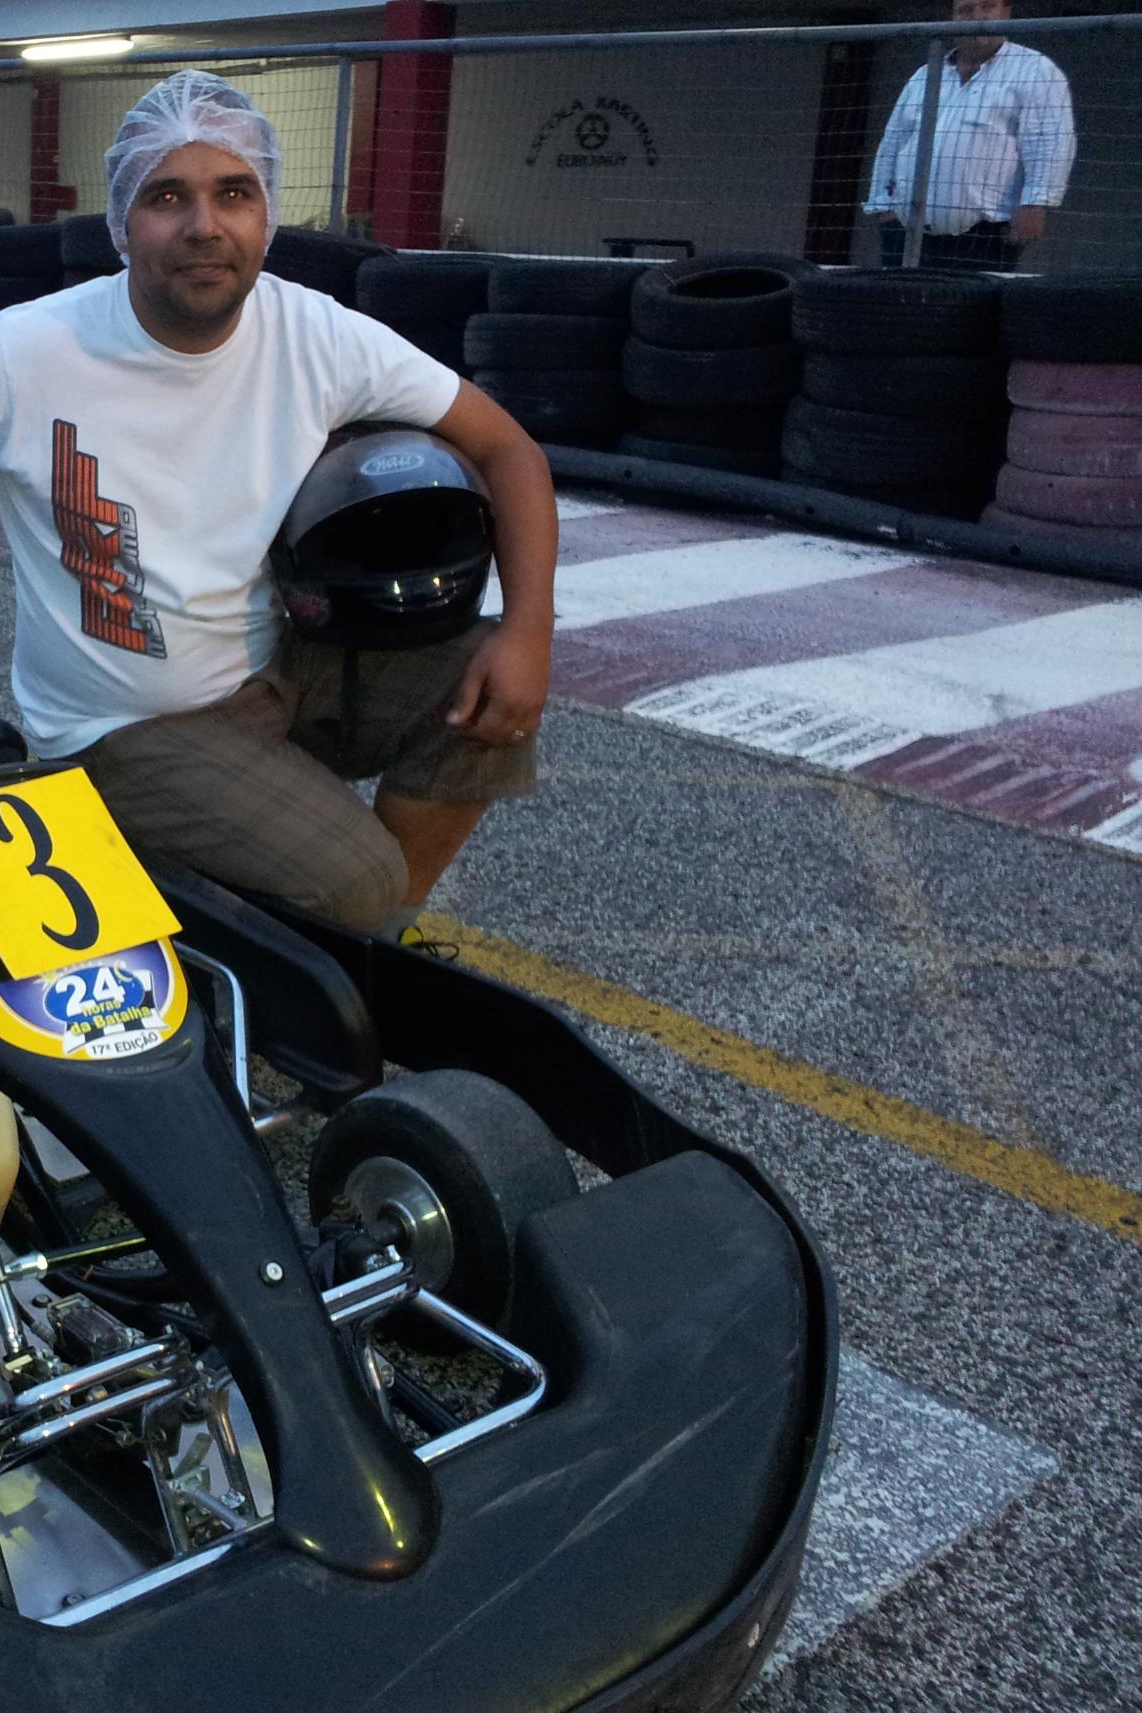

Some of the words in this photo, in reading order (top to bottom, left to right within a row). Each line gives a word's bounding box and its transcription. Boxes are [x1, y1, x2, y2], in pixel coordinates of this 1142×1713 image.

[55, 966, 126, 1018] 24
[69, 1020, 92, 1037] da
[93, 1005, 152, 1030] Batalha
[114, 1030, 159, 1053] EDIÇÃO
